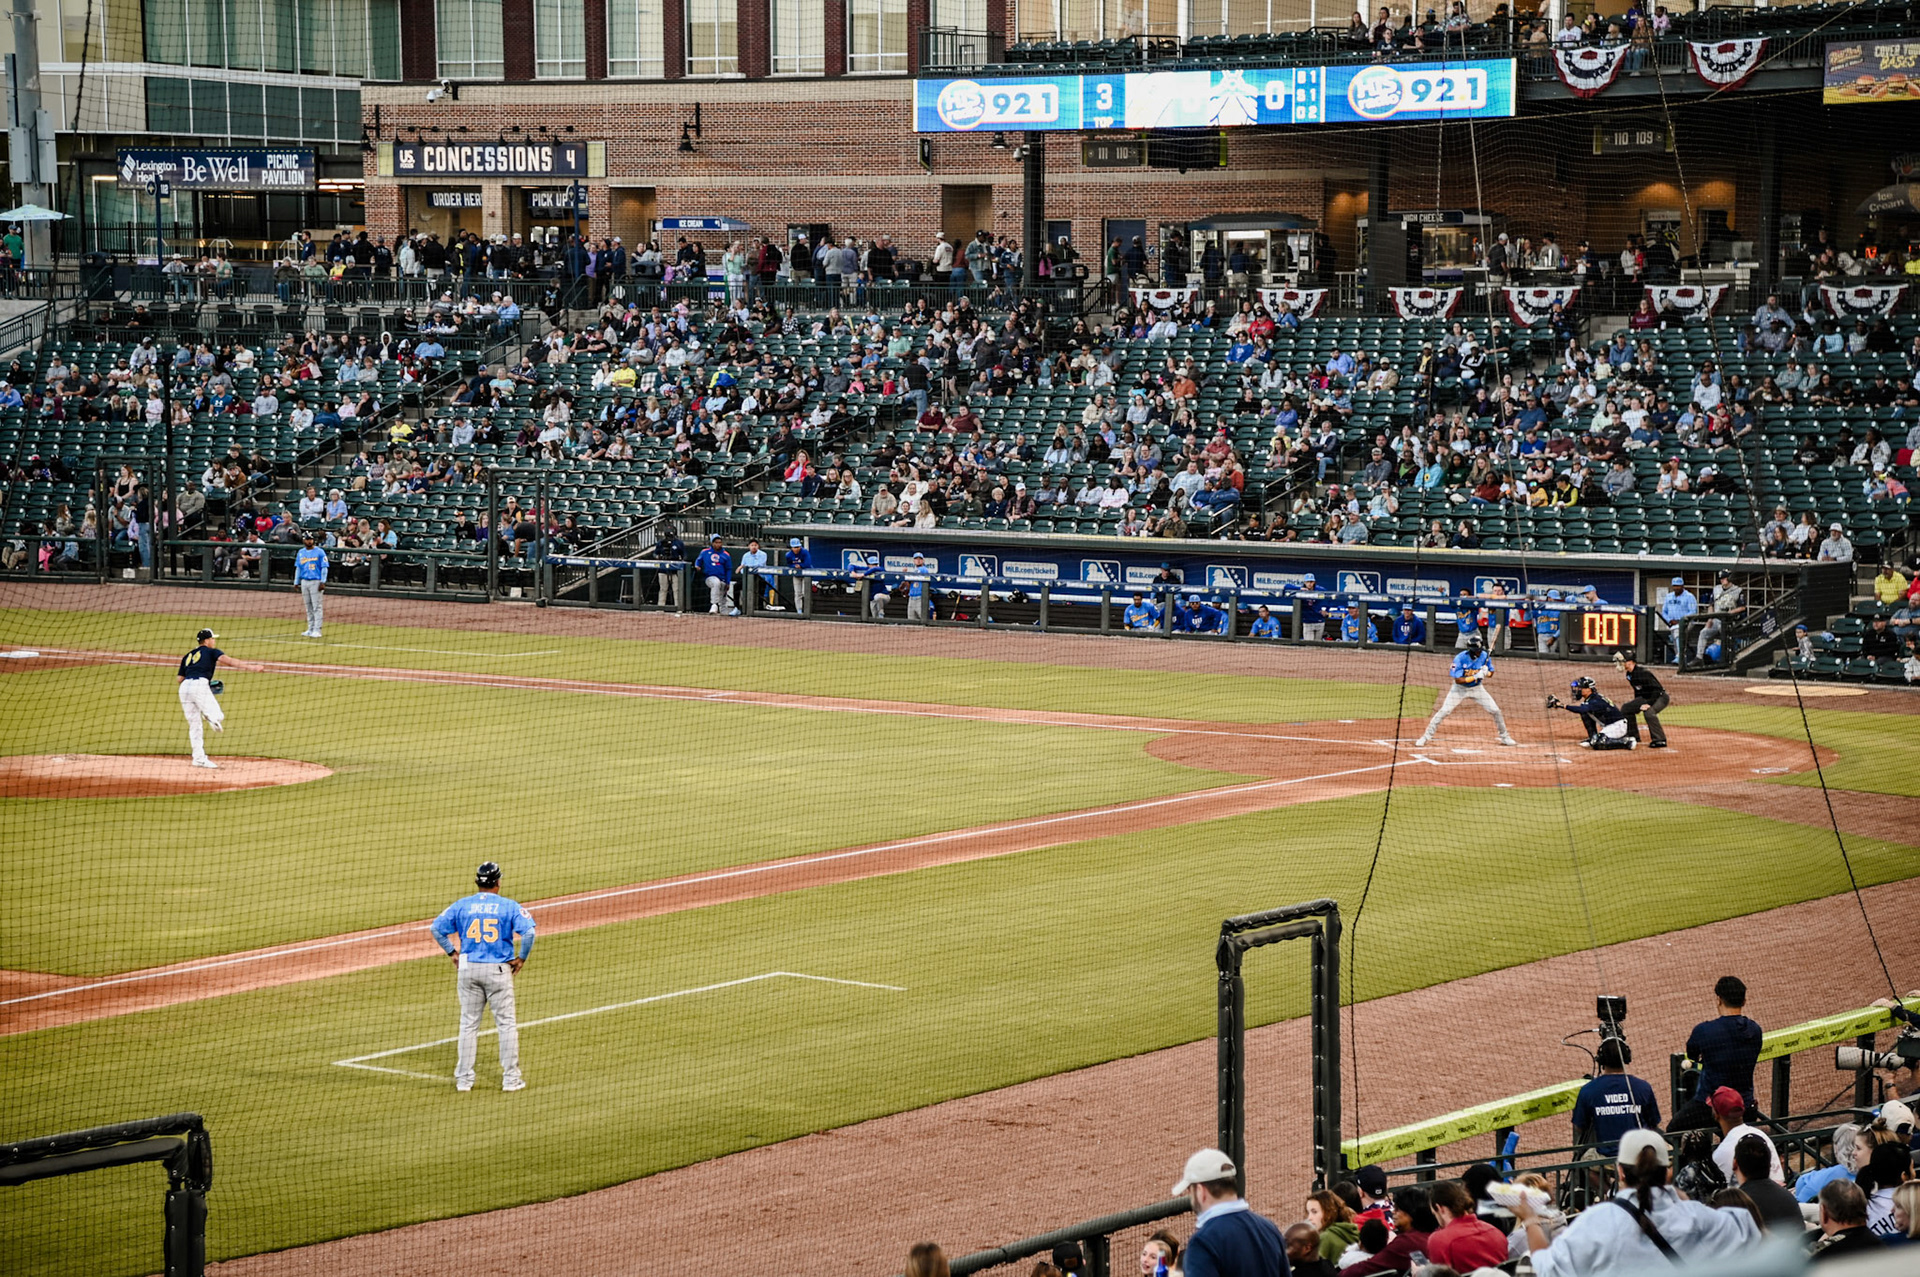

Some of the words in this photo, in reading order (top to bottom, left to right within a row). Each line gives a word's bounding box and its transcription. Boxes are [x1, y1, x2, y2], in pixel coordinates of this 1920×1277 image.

[1310, 70, 1316, 84] 1
[1096, 83, 1113, 110] 3
[1265, 80, 1285, 111] 0
[1310, 88, 1316, 102] 1
[1308, 105, 1317, 119] 2
[1093, 116, 1114, 128] TOP
[1614, 132, 1629, 146] 110
[1636, 131, 1653, 145] 109
[423, 146, 552, 172] CONCESSIONS
[566, 150, 576, 169] 4
[1098, 147, 1108, 160] 111
[1116, 147, 1128, 159] 110
[136, 159, 177, 175] Lexington
[266, 154, 299, 169] PICNIC
[182, 156, 207, 182] Be
[206, 156, 249, 182] Well
[136, 171, 164, 182] Healh
[261, 169, 305, 185] PAVILION
[160, 184, 169, 194] 112
[432, 192, 462, 206] ORDER
[463, 192, 482, 206] HER
[532, 193, 553, 207] PICK
[555, 193, 568, 207] UP
[1868, 199, 1905, 213] Cream
[1005, 566, 1056, 575] MiLB.com/tickets
[466, 918, 499, 943] 45
[1604, 1093, 1628, 1104] VIDEO
[1595, 1105, 1642, 1116] PRODUCTION
